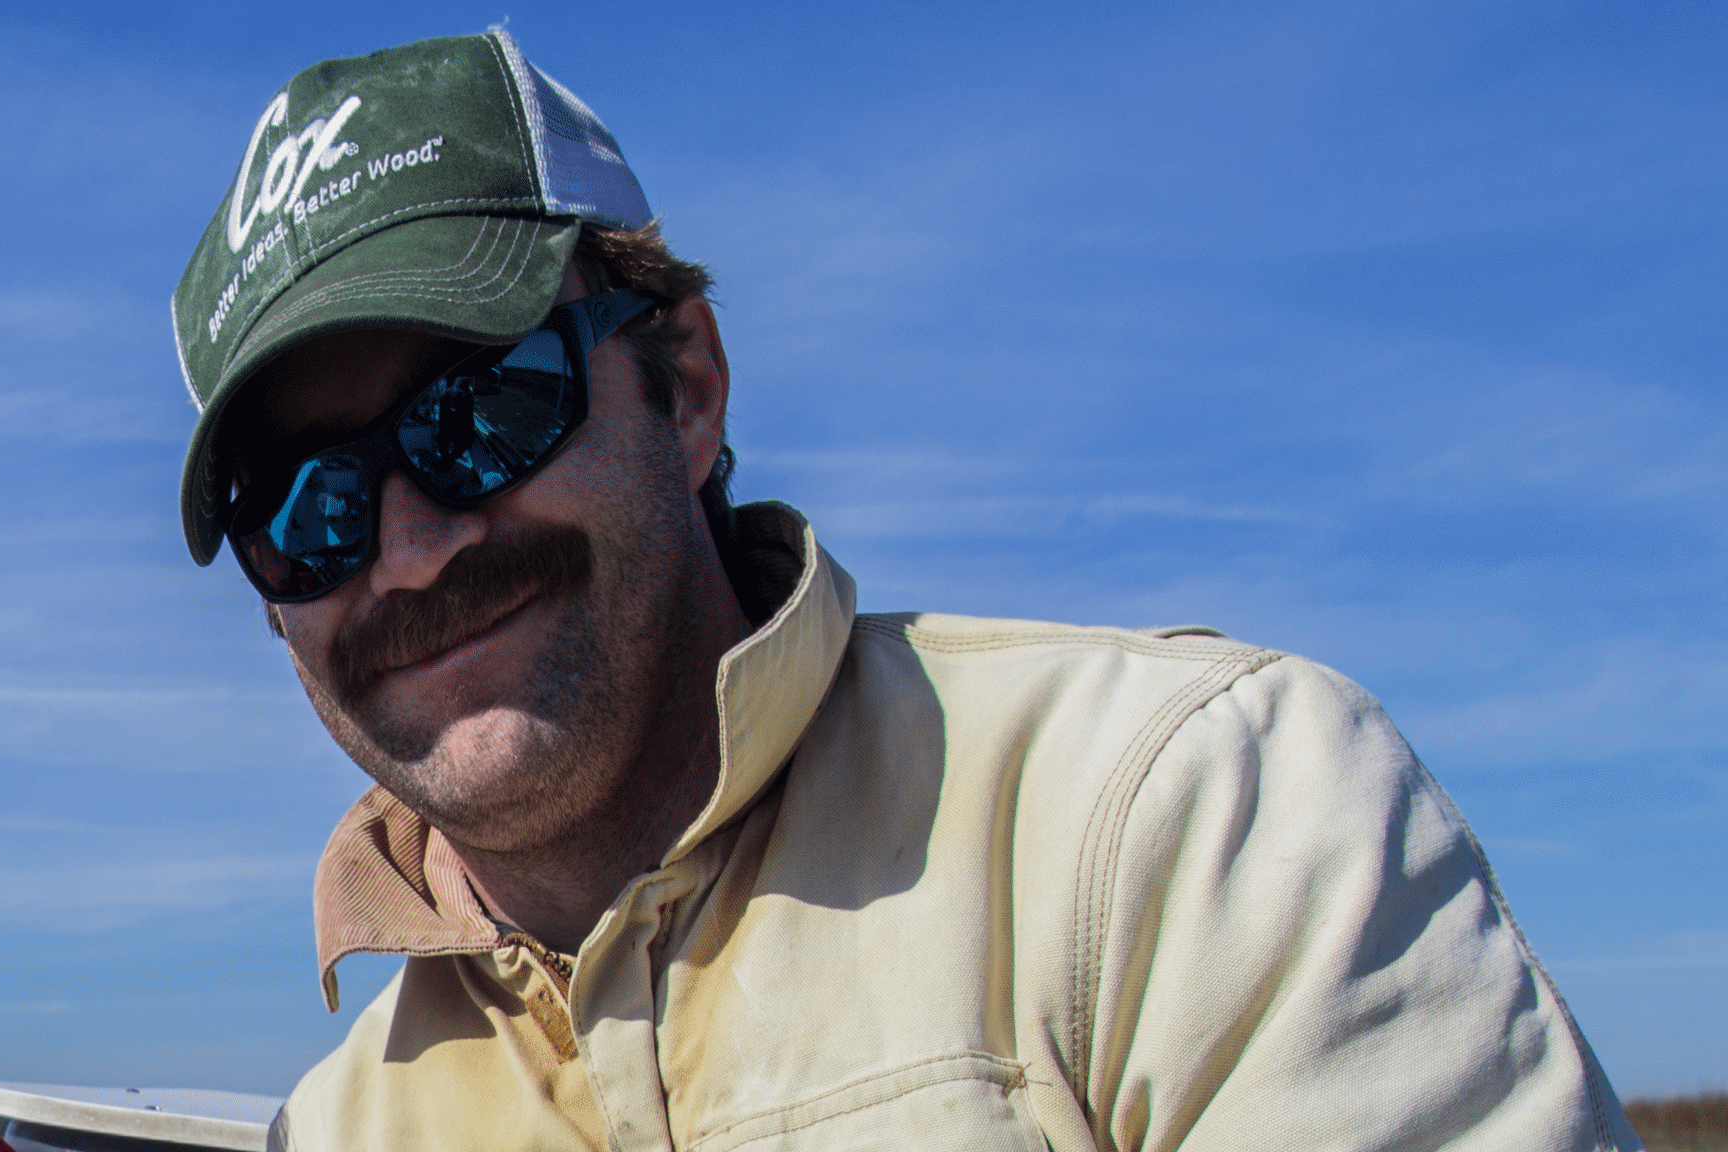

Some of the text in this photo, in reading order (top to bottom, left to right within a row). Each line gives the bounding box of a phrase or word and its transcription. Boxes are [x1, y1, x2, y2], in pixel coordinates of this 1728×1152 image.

[208, 272, 241, 343] Better
[241, 221, 290, 282] Ideas.
[293, 170, 363, 226] Better
[227, 91, 362, 254] Cox
